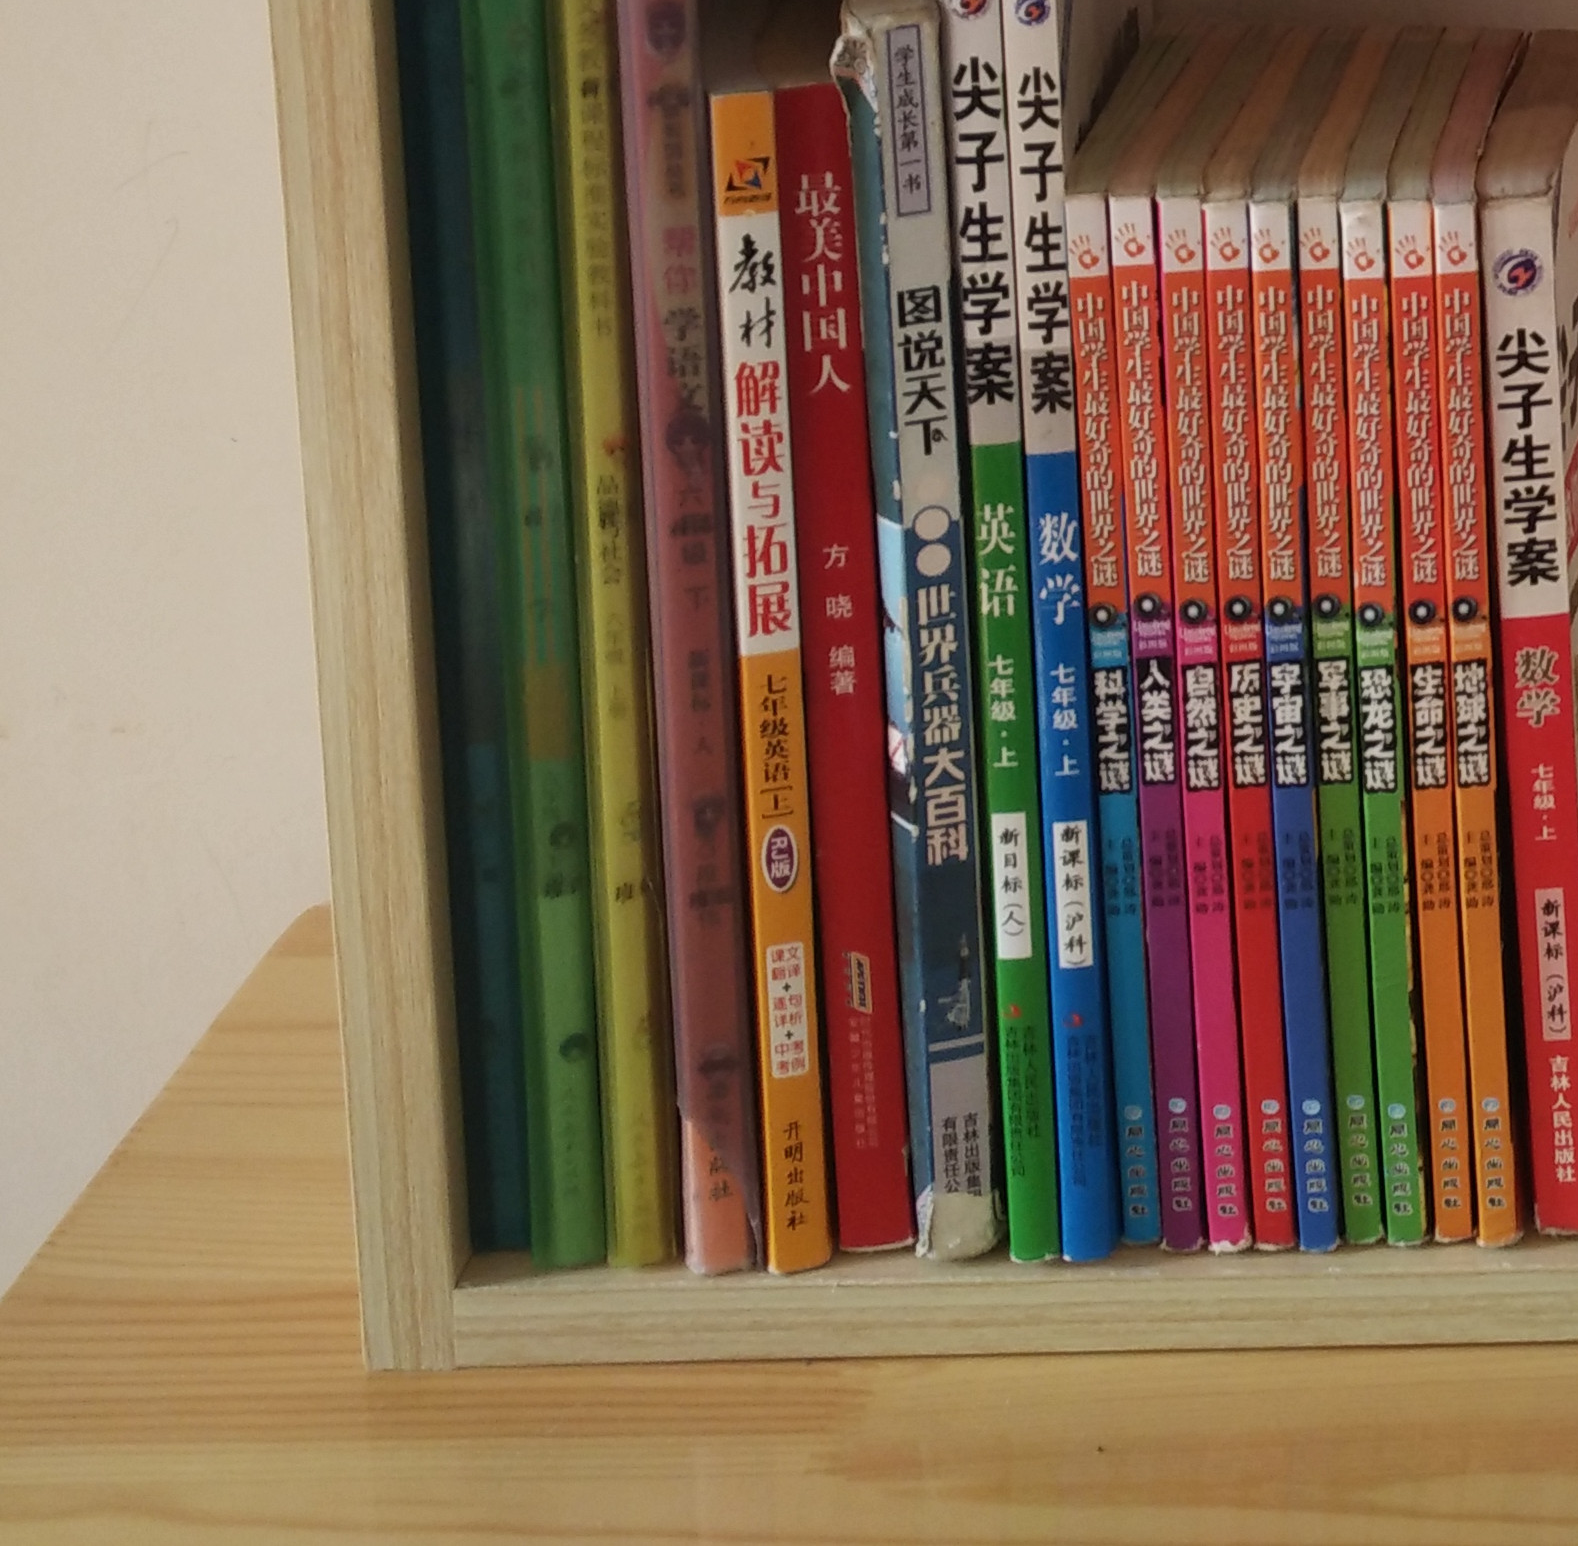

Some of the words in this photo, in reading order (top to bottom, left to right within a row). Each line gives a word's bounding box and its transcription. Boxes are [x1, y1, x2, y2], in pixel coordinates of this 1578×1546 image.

[894, 44, 921, 195] 学生成长第一书
[794, 171, 851, 396] 最美中国人
[952, 56, 1016, 406] 尖子生学案
[1017, 67, 1073, 414] 尖子生学案
[897, 285, 949, 456] 图说天下
[1121, 280, 1163, 577] 中国学生最好奇的世界之谜
[1217, 285, 1254, 581] 中国学生最好奇的世界之谜
[1258, 286, 1295, 582] 中国学生最好奇的世界之谜
[1307, 285, 1343, 578] 中国学生最好奇的世界之谜
[1077, 292, 1118, 587] 中国学生最好奇的世界之谜
[1172, 286, 1209, 584] 中国学生最好奇的世界之谜
[1352, 294, 1388, 587] 中国学生最好奇的世界之谜
[1402, 292, 1438, 584] 中国学生最好奇的世界之谜
[1444, 288, 1479, 582] 中国学生最好奇的世界之谜
[1495, 327, 1560, 587] 尖子生学案
[975, 503, 1018, 619] 英语
[1038, 512, 1079, 625] 数学
[915, 582, 968, 866] 世界兵器大百科
[987, 655, 1018, 768] 七年级·上
[1050, 664, 1080, 777] 七年级·上
[1094, 668, 1131, 792] 科学之谜
[1141, 659, 1175, 782] 人类之谜
[1185, 666, 1221, 788] 自然之谜
[1230, 663, 1266, 786] 历史之谜
[1270, 663, 1308, 786] 宇宙之谜
[1318, 660, 1352, 782] 军事之谜
[1361, 666, 1396, 791] 恐龙之谜
[1412, 665, 1447, 788] 生命之谜
[1454, 664, 1490, 785] 地球之谜
[1515, 646, 1560, 729] 数学
[1531, 763, 1557, 841] 七年级·上
[998, 828, 1025, 937] 新目标（人）
[1059, 826, 1087, 966] 新课标（沪科）
[1540, 898, 1567, 1034] 新课标（沪科）
[781, 1121, 808, 1231] 开明出版社
[942, 1116, 960, 1194] 有限责任公
[1549, 1055, 1577, 1183] 吉林人民出版社
